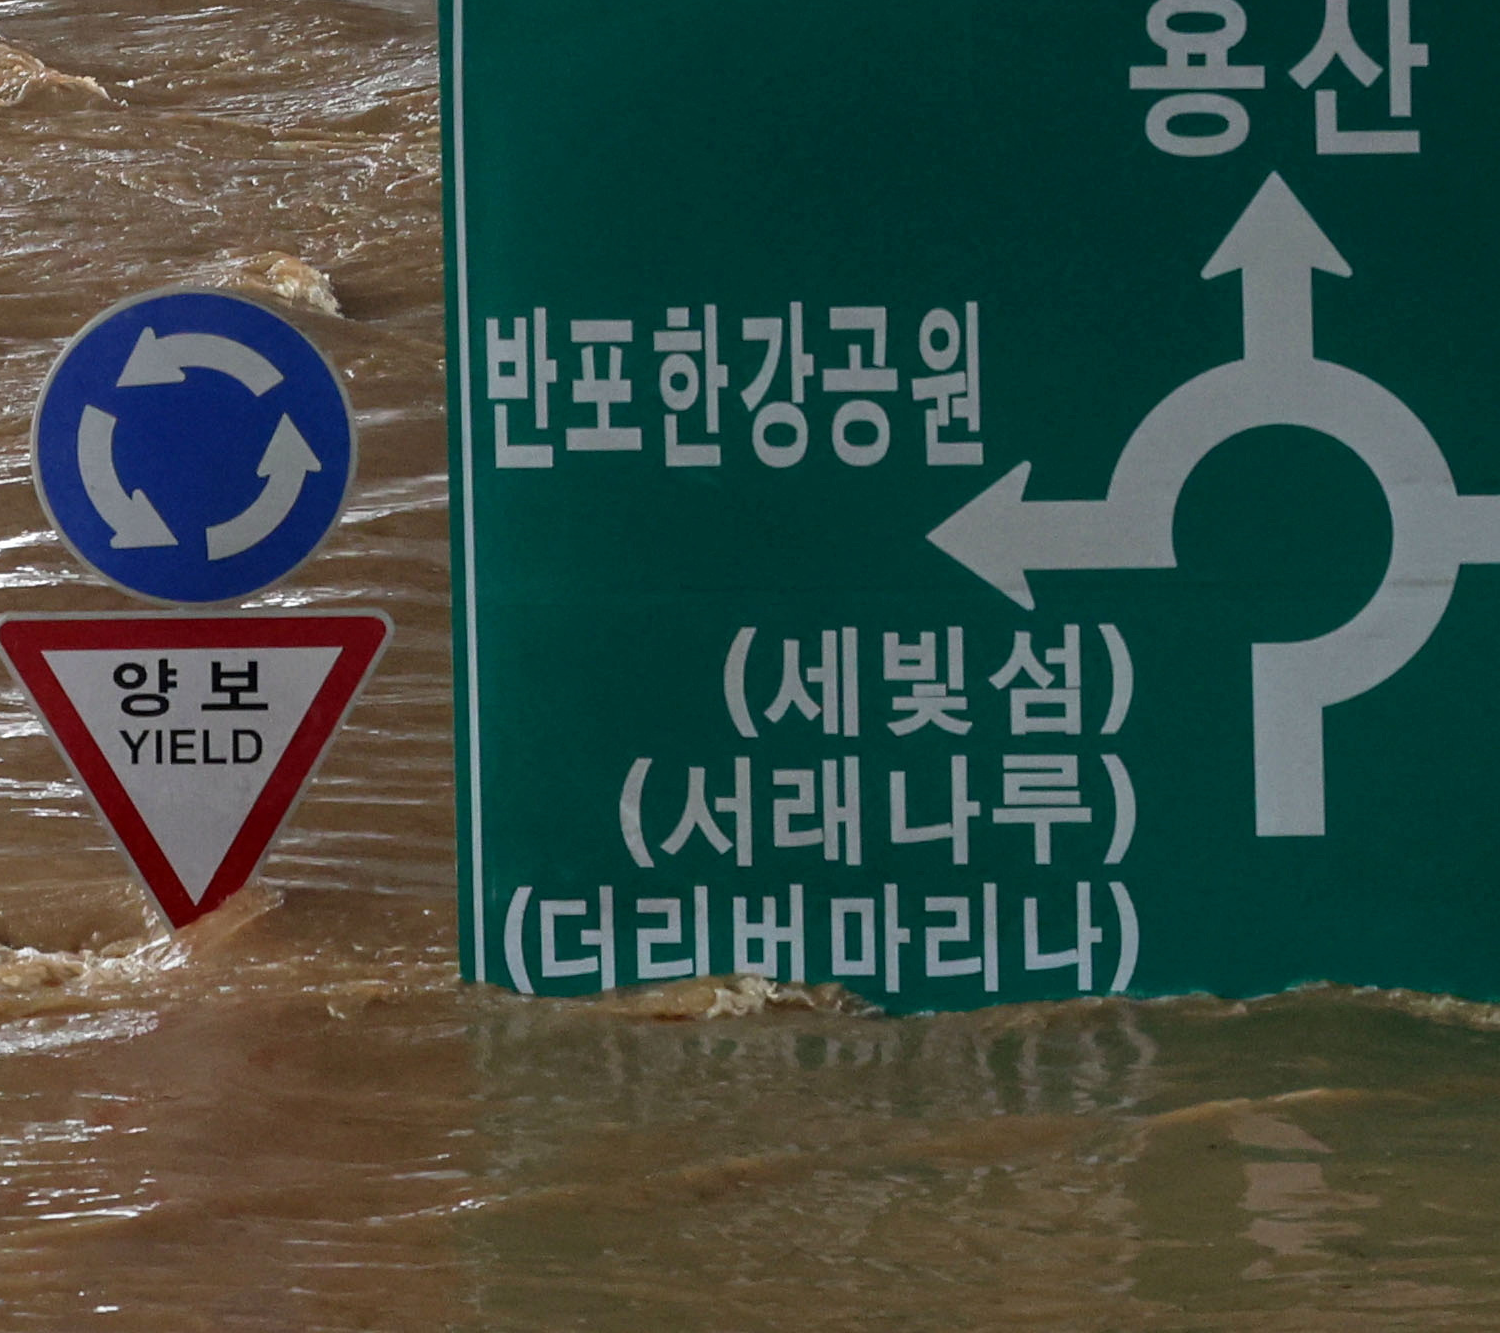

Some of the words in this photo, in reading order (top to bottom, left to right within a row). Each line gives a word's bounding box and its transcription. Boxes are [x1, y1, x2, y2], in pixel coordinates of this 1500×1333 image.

[486, 300, 984, 469] 반포한강공원
[112, 658, 269, 717] 양보
[723, 623, 1135, 738] (세빛섬)
[119, 729, 263, 765] YIELD
[619, 754, 1137, 867] (서래나루)
[503, 881, 1140, 994] (더리버마리나)
